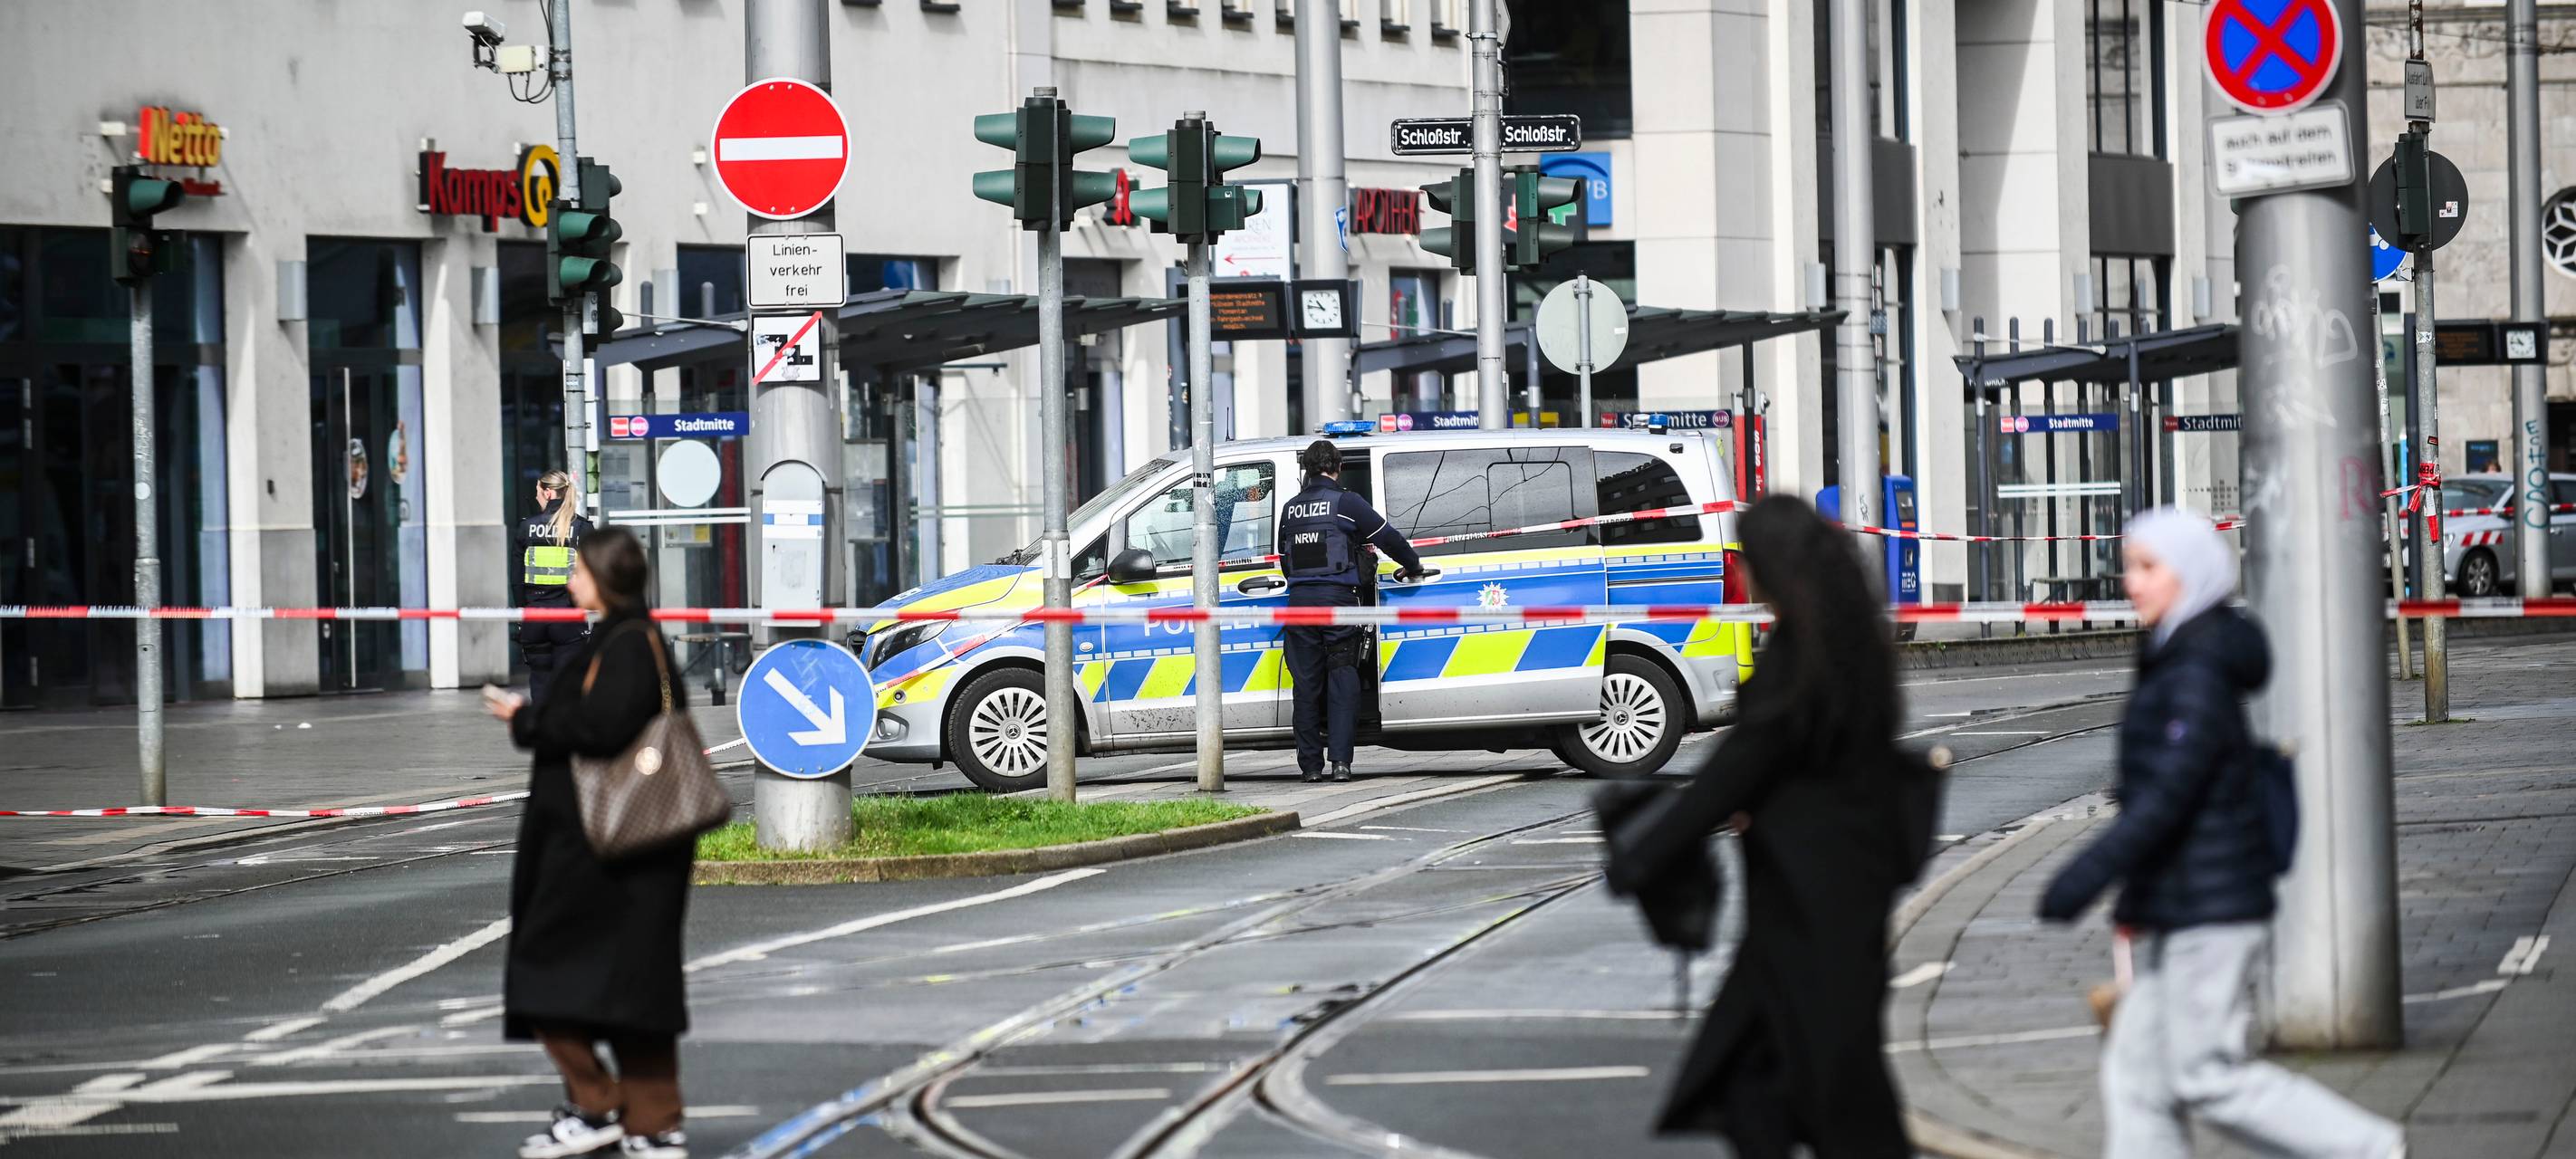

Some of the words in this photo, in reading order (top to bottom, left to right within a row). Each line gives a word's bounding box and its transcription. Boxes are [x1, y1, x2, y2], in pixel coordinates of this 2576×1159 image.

[141, 107, 220, 166] Netto
[1401, 129, 1466, 145] Schloßstr.
[1505, 125, 1571, 142] Schloßstr.
[427, 151, 523, 233] Kamps
[773, 244, 817, 256] Linien-
[770, 265, 822, 276] verkehr
[785, 284, 808, 297] frei
[674, 418, 735, 431] Stadtmitte
[1433, 415, 1478, 427] Stadtmit
[1624, 413, 1707, 427] Smitte
[2048, 417, 2093, 428] Stadtmitte
[2184, 416, 2243, 430] Stadtmit
[1288, 502, 1330, 519] POLIZEI
[1295, 532, 1319, 543] NRW
